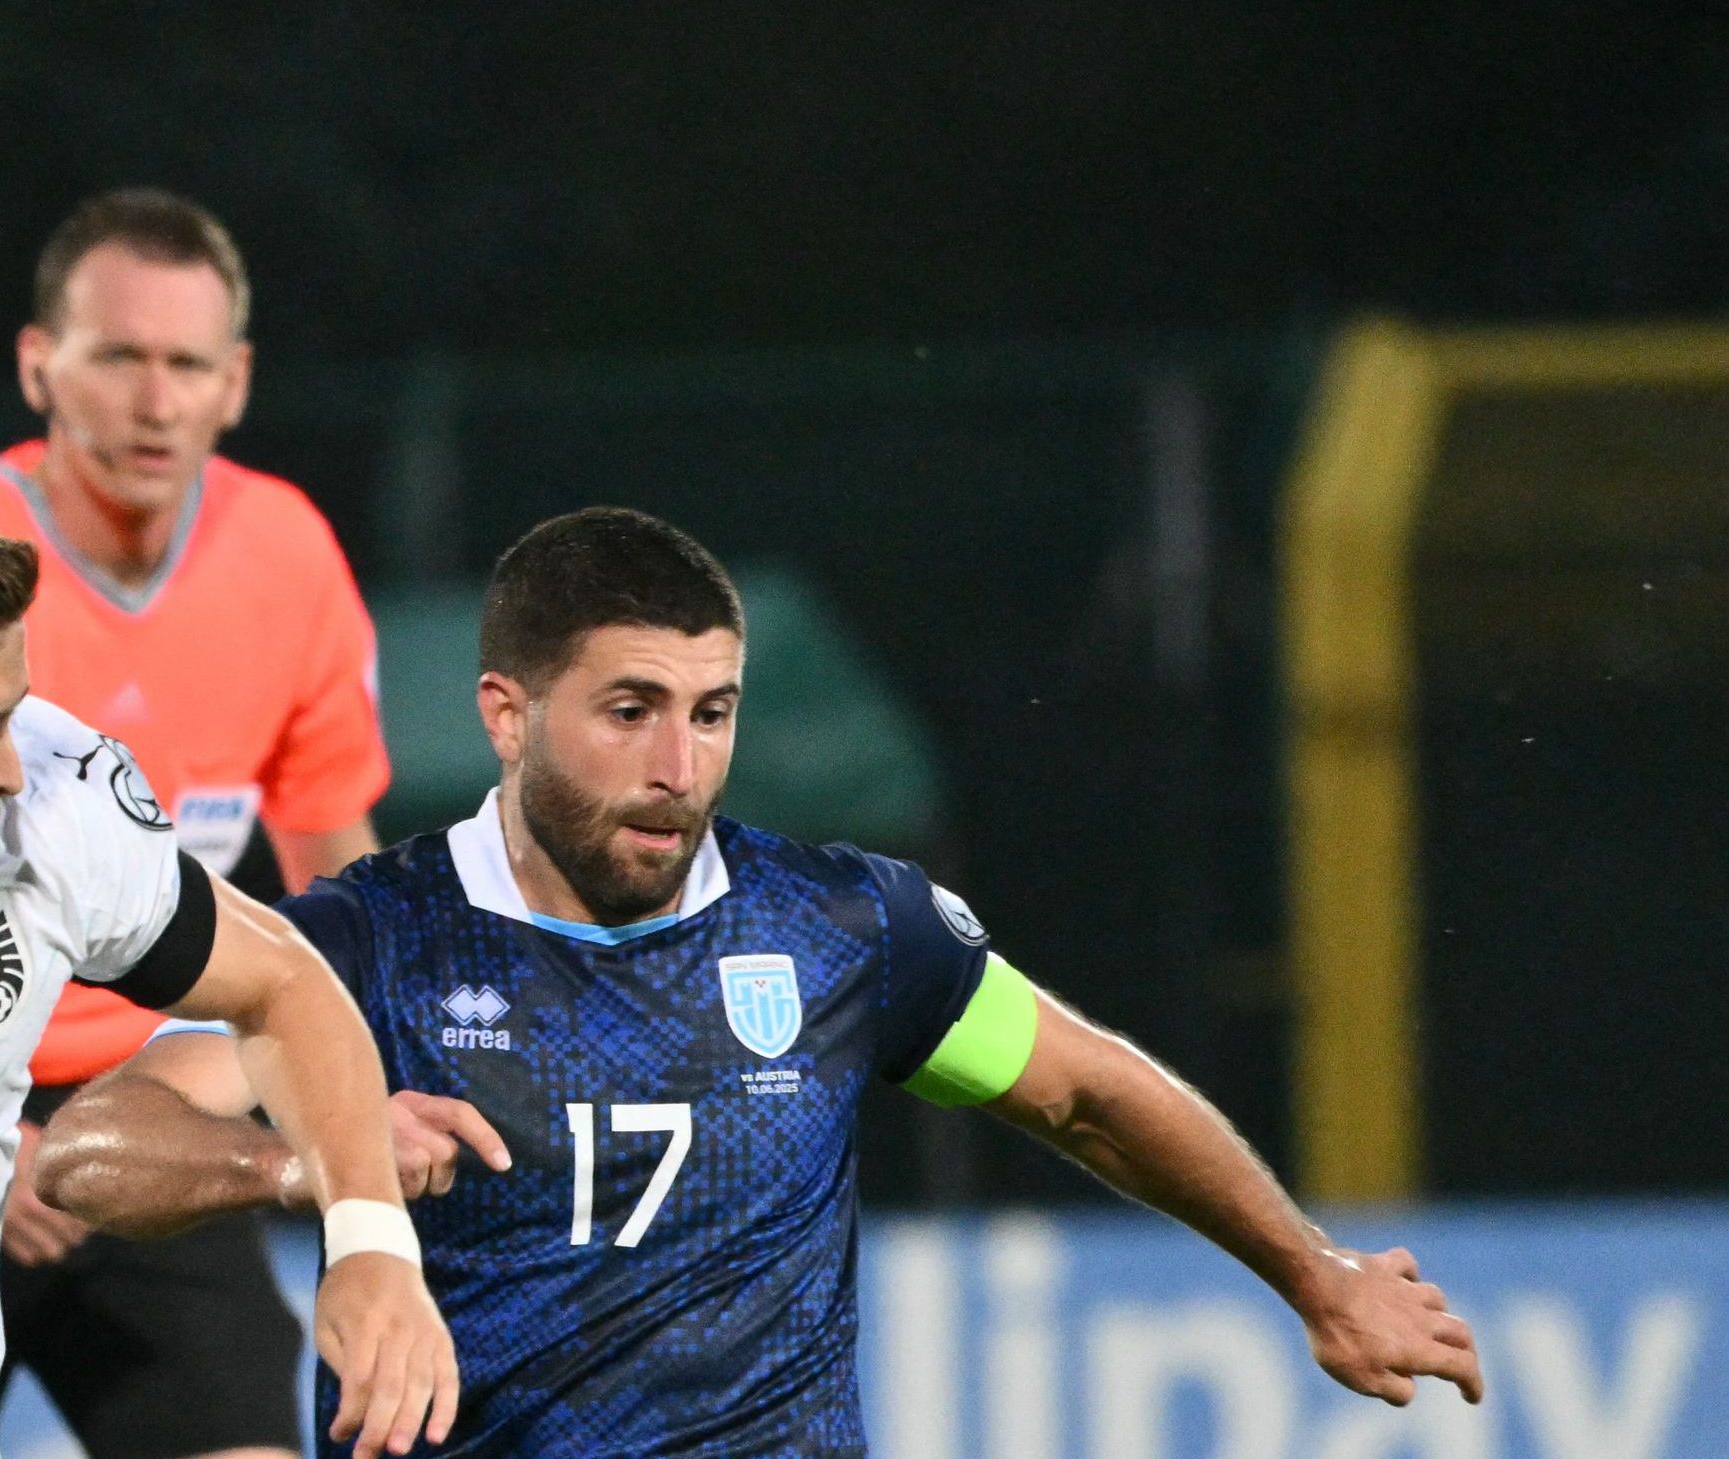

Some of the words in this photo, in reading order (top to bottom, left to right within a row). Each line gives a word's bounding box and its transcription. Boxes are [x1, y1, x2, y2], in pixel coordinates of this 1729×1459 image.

[442, 1027, 511, 1051] errea
[754, 1070, 802, 1081] AUSTRIA
[745, 1082, 799, 1095] 10.06.2025
[565, 1103, 692, 1248] 17
